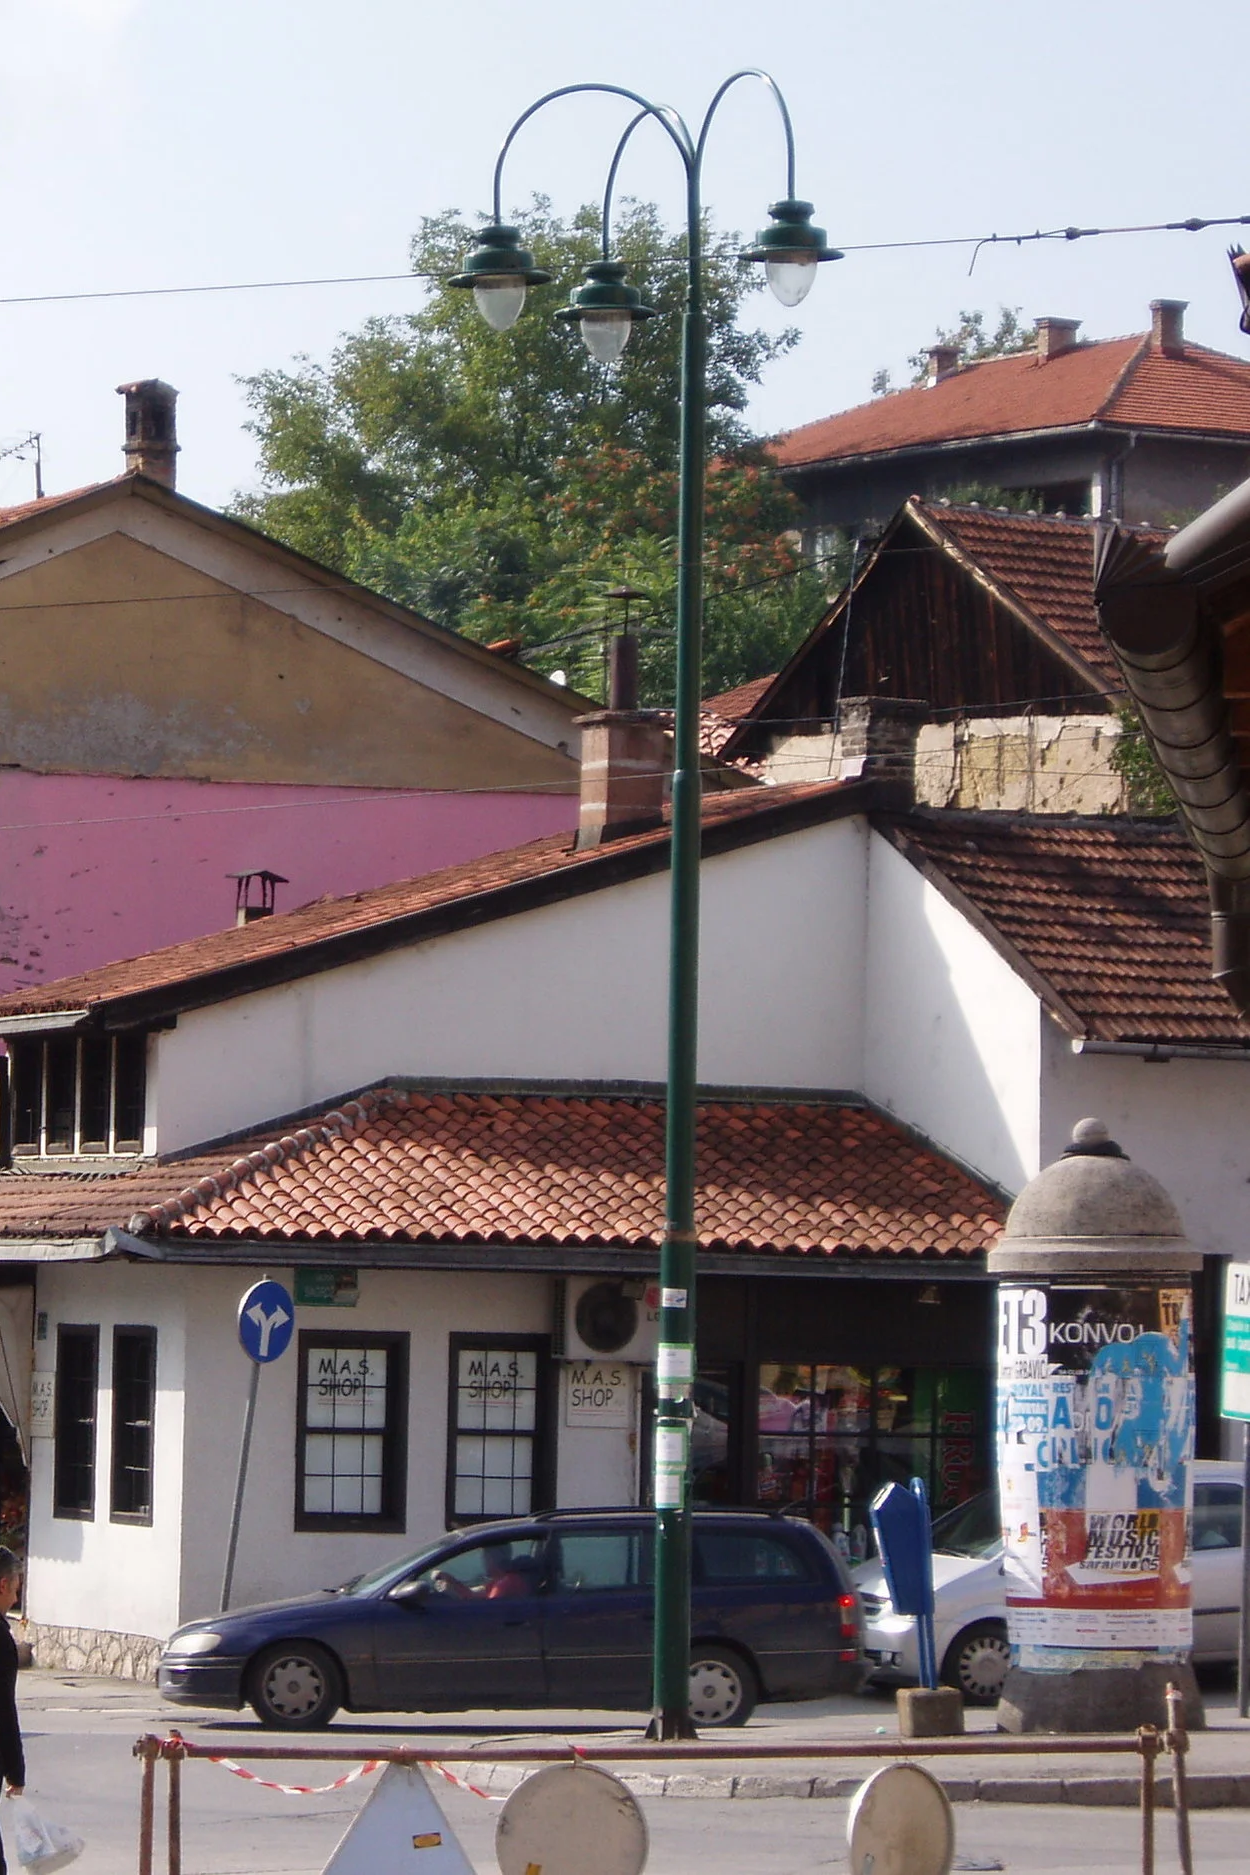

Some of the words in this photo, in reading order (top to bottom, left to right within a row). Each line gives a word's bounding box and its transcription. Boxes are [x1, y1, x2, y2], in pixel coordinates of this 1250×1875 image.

[318, 1358, 374, 1376] M.A.S.
[468, 1361, 524, 1379] M.A.S.
[571, 1369, 626, 1386] M.A.S.
[318, 1378, 362, 1396] SHOP
[468, 1380, 511, 1398] SHOP
[572, 1389, 614, 1407] SHOP
[1090, 1514, 1160, 1530] WORLD
[1087, 1530, 1160, 1547] MUSIC
[1086, 1545, 1160, 1559] FESTIVAL
